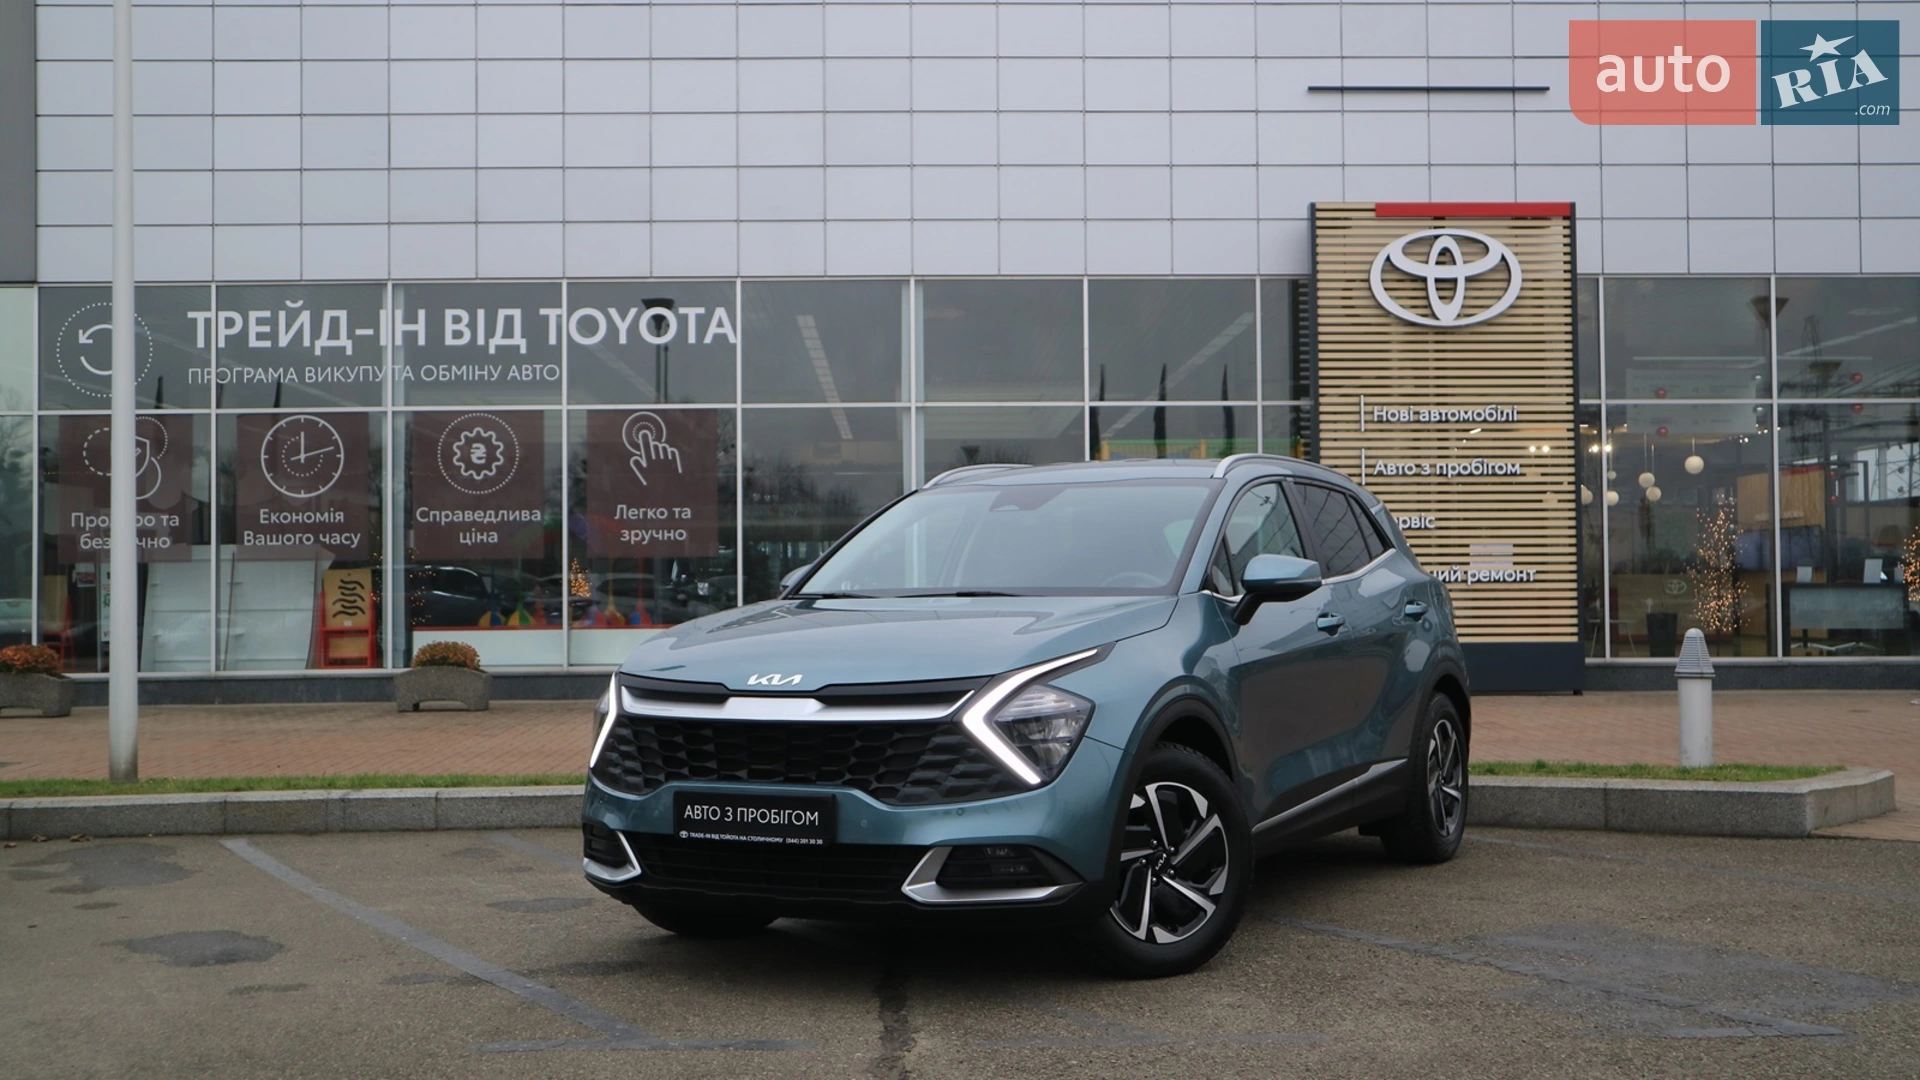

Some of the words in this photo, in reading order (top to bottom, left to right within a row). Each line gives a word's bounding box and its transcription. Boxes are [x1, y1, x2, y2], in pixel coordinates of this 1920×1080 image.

[187, 300, 426, 356] ТРЕЙД-ІН
[444, 308, 527, 354] ВІД
[539, 306, 737, 346] TOYOTA
[188, 366, 299, 385] ПРОГРАМА
[304, 365, 387, 383] ВИКУПУ
[391, 364, 415, 382] ТА
[420, 364, 502, 382] ОБМІНУ
[506, 364, 560, 381] АВТО
[1373, 405, 1415, 422] Нові
[1419, 404, 1519, 422] автомобілі
[1373, 459, 1417, 476] Авто
[1420, 462, 1431, 476] з
[1435, 458, 1521, 478] пробігом
[259, 508, 345, 524] Економія
[415, 507, 542, 525] Справедлива
[614, 504, 668, 520] Легко
[672, 506, 692, 520] та
[1393, 512, 1436, 531] рвіс
[71, 512, 156, 532] Проо
[160, 514, 180, 527] та
[80, 533, 171, 549] безчно
[243, 531, 314, 547] Вашого
[319, 531, 361, 548] часу
[459, 527, 498, 546] ціна
[620, 526, 687, 546] зручно
[1467, 567, 1537, 586] ремонт
[747, 673, 803, 686] KIA
[683, 804, 721, 821] АВТО
[737, 807, 819, 826] ПРОБІГОМ
